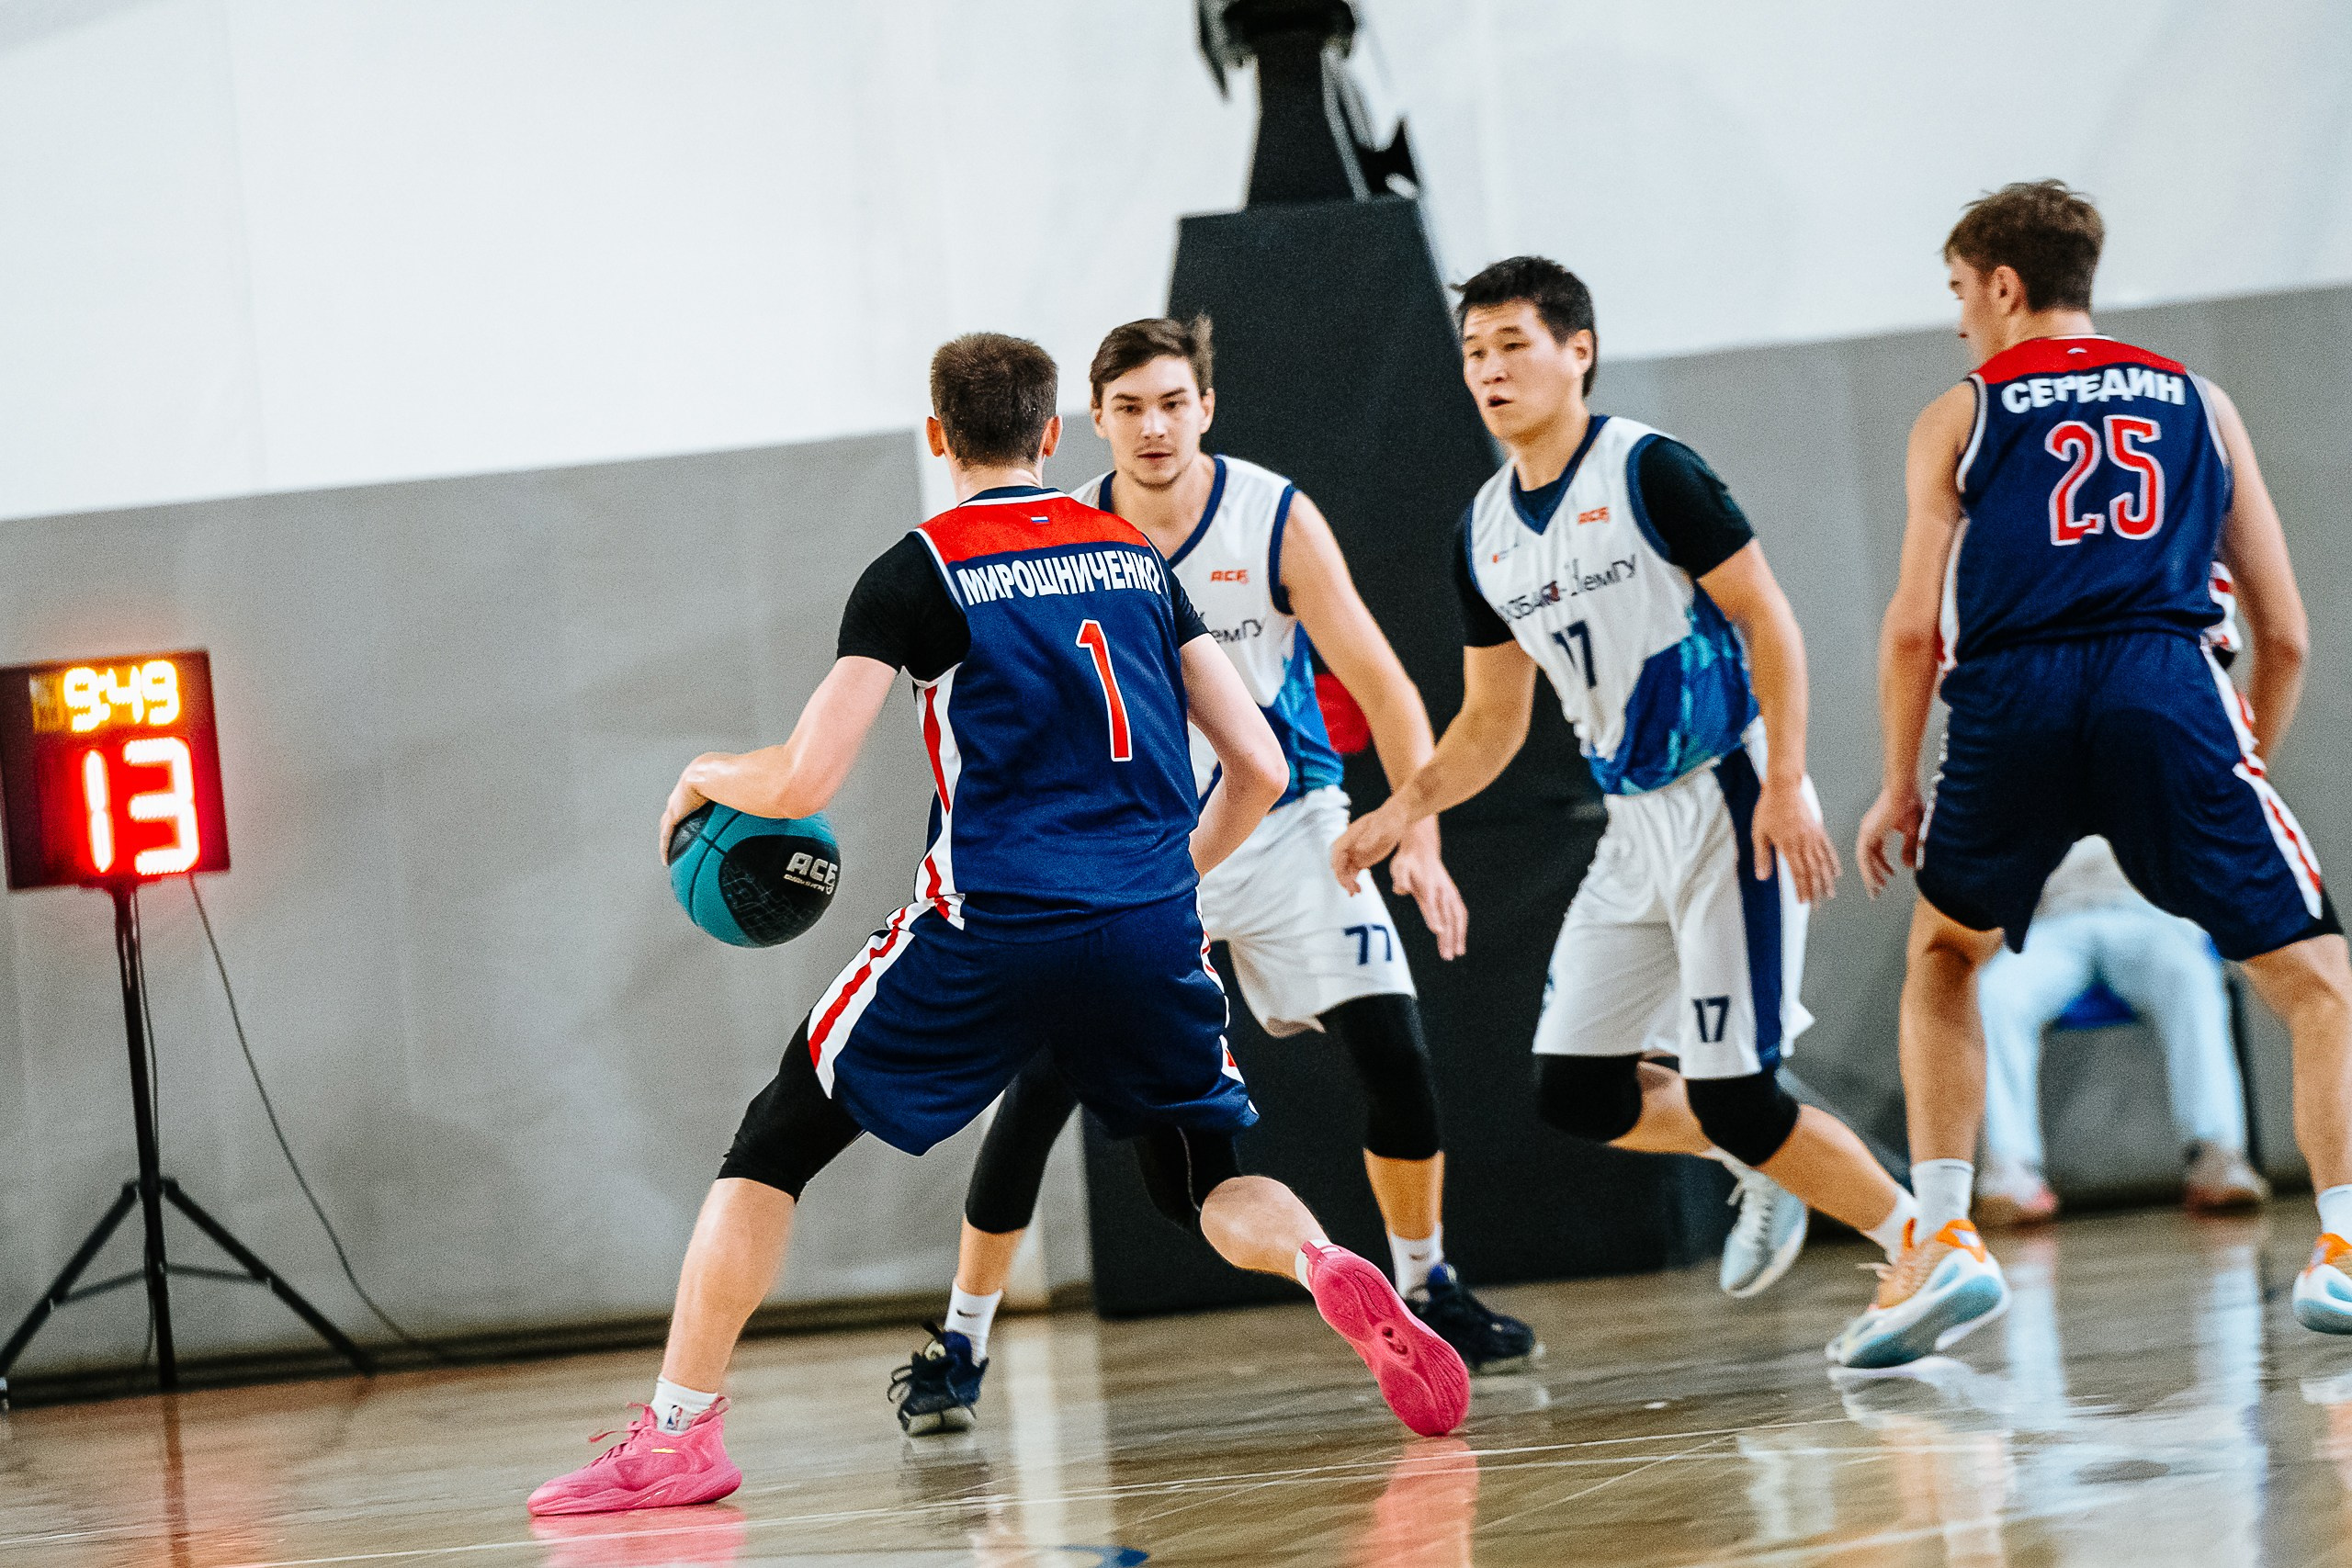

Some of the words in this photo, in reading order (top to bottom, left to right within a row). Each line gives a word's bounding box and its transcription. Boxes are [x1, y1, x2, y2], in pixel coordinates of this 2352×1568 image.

[2001, 367, 2186, 413] СЕРЕДИН
[2044, 414, 2165, 547] 25
[1076, 619, 1132, 761] 1
[1552, 620, 1597, 689] 17
[63, 660, 179, 733] 9:49
[83, 737, 199, 875] 13
[1344, 924, 1392, 964] 77
[1692, 996, 1729, 1043] 17
